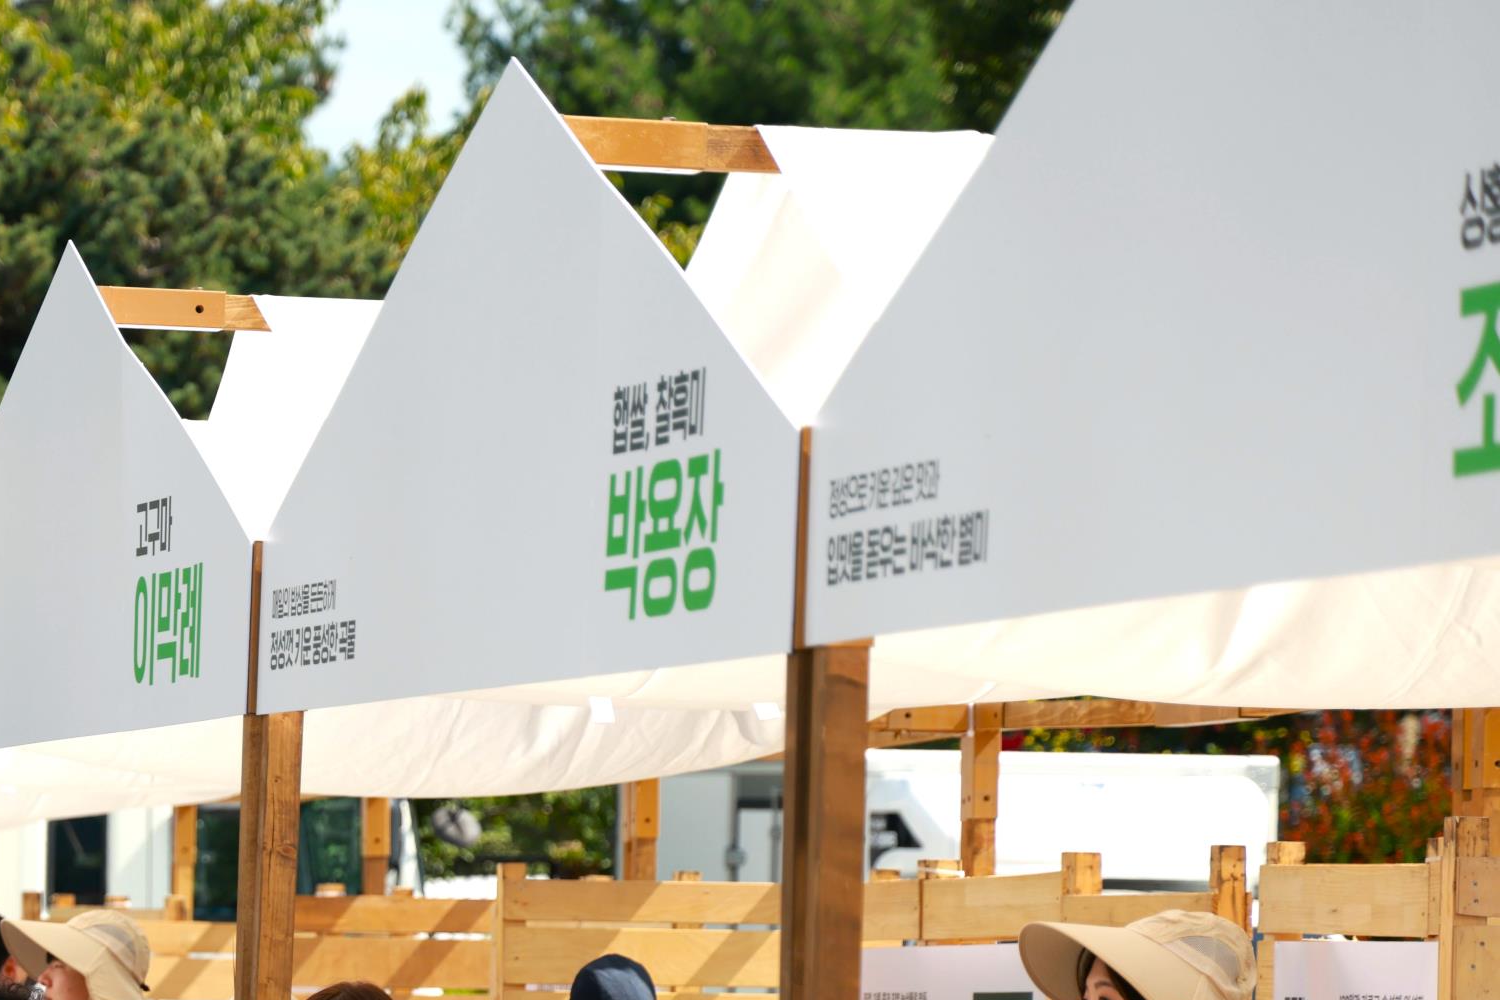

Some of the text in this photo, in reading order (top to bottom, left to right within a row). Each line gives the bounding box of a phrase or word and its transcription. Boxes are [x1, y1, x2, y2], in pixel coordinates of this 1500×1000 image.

[612, 366, 707, 455] 햅쌀, 찰흑미
[829, 473, 868, 520] 정성으로
[869, 467, 891, 510] 키운
[916, 458, 940, 501] 맛과
[135, 495, 173, 557] 고구마
[604, 447, 724, 621] 박용장
[827, 508, 989, 587] 입맛을 돋우는 바삭한 별미
[133, 562, 203, 686] 이막례
[291, 583, 310, 616] 밥상을
[311, 578, 337, 614] 든든하게
[270, 619, 357, 671] 정성껏 키운 풍성한 곡물
